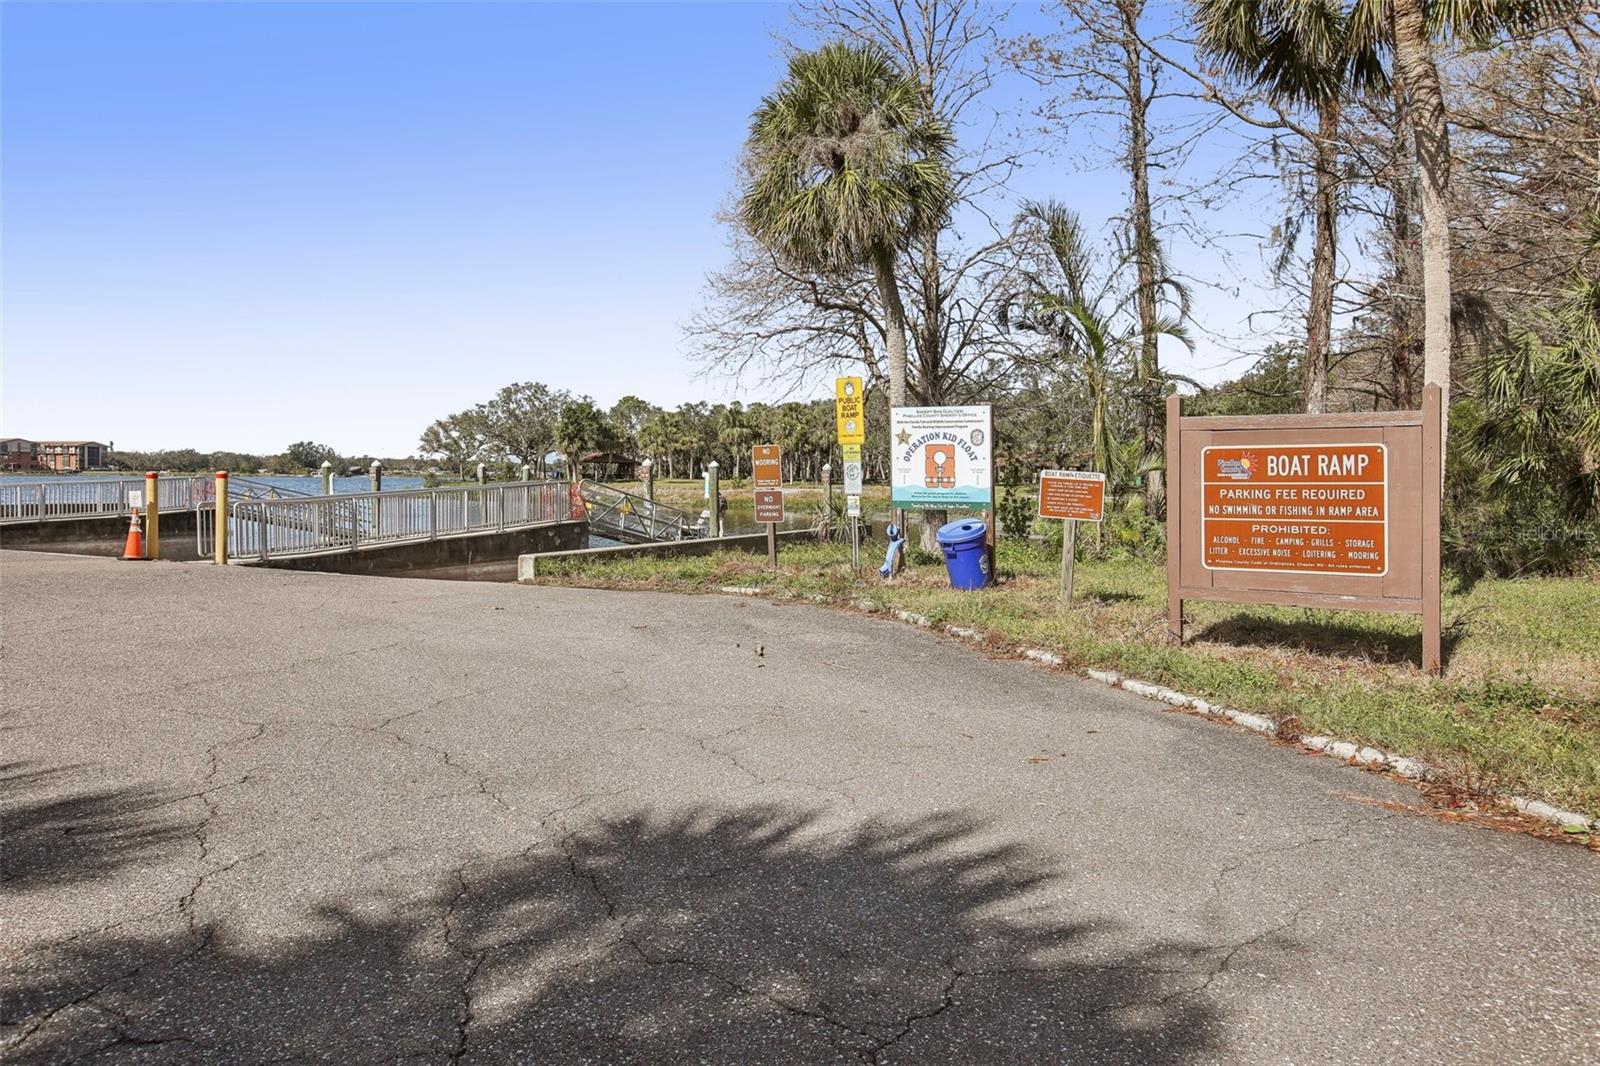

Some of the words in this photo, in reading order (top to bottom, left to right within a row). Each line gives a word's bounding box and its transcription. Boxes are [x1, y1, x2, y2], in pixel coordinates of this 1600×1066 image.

[838, 396, 860, 404] PUBLIC
[903, 432, 940, 462] OPERATION
[942, 432, 958, 443] KID
[957, 438, 978, 461] FLOAT
[1267, 455, 1310, 476] BOAT
[1318, 454, 1369, 476] RAMP
[1219, 489, 1271, 499] PARKING
[1275, 489, 1297, 499] FEE
[1302, 489, 1366, 500] REQUIRED
[1209, 505, 1220, 514] NO
[1222, 505, 1263, 515] SWIMMING
[1265, 505, 1277, 515] OR
[1280, 505, 1313, 516] FISHING
[1316, 506, 1325, 516] IN
[1328, 506, 1353, 516] RAMP
[1355, 506, 1379, 517] AREA
[1252, 524, 1331, 535] PROHIBITED:
[1212, 536, 1240, 544] ALCOHOL
[1251, 537, 1265, 545] FIRE
[1275, 537, 1304, 546] CAMPING
[1311, 538, 1334, 547] GRILLS
[1345, 539, 1375, 548] STORAGE
[1209, 547, 1228, 555] LITTER
[1238, 547, 1270, 556] EXCESSIVE
[1272, 549, 1291, 557] NOISE
[1302, 550, 1336, 559] LOITERING
[1347, 551, 1379, 560] MOORING
